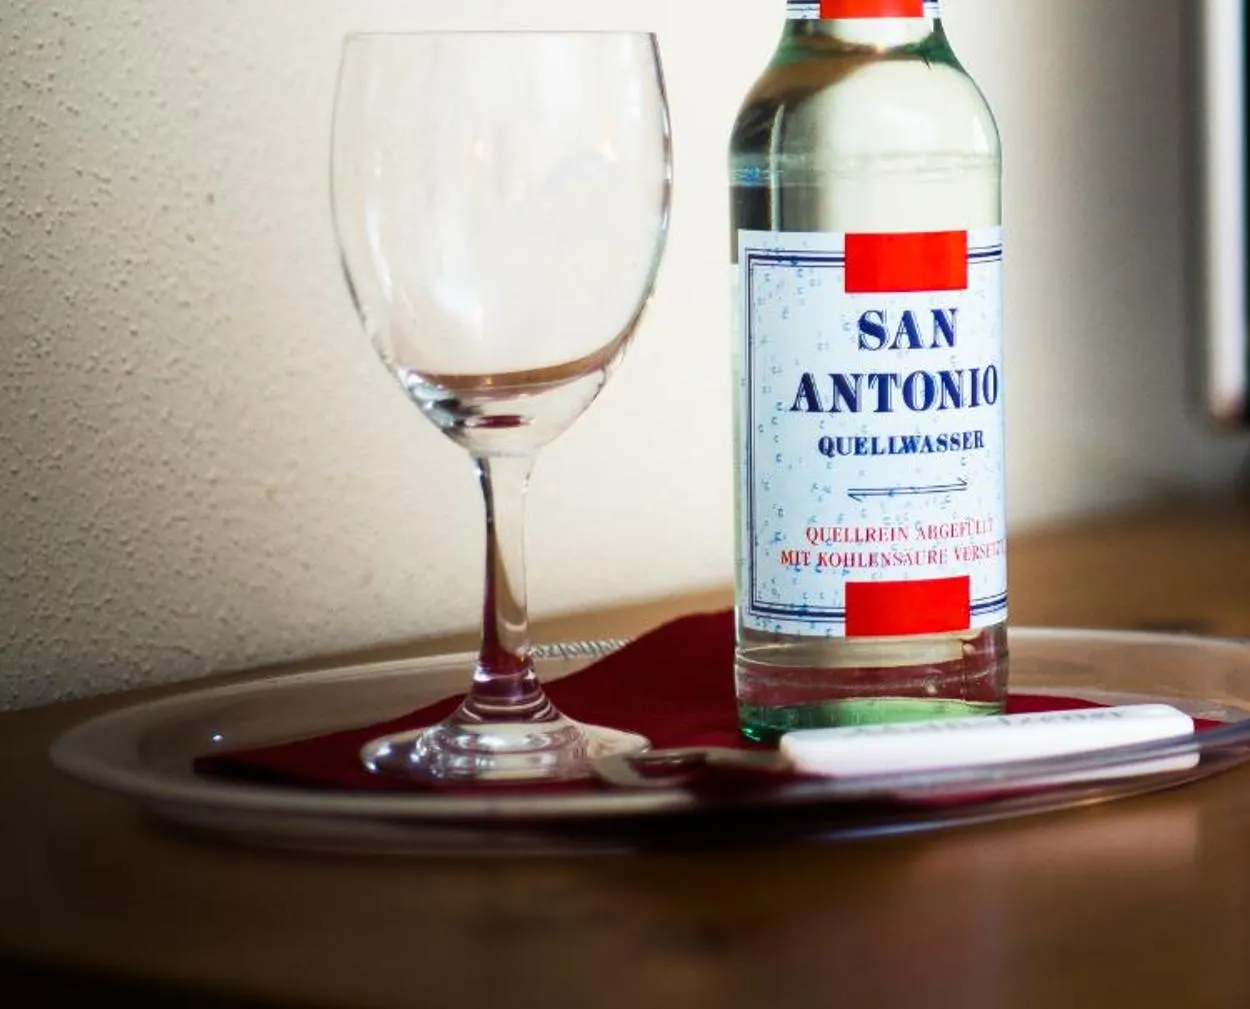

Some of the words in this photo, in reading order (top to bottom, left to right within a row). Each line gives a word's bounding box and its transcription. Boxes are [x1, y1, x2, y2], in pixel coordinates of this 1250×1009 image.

[858, 308, 957, 350] SAN
[790, 364, 998, 413] ANTONIO
[818, 429, 985, 458] QUELLWASSER
[806, 524, 910, 546] QUELLREIN
[781, 550, 812, 568] MIT
